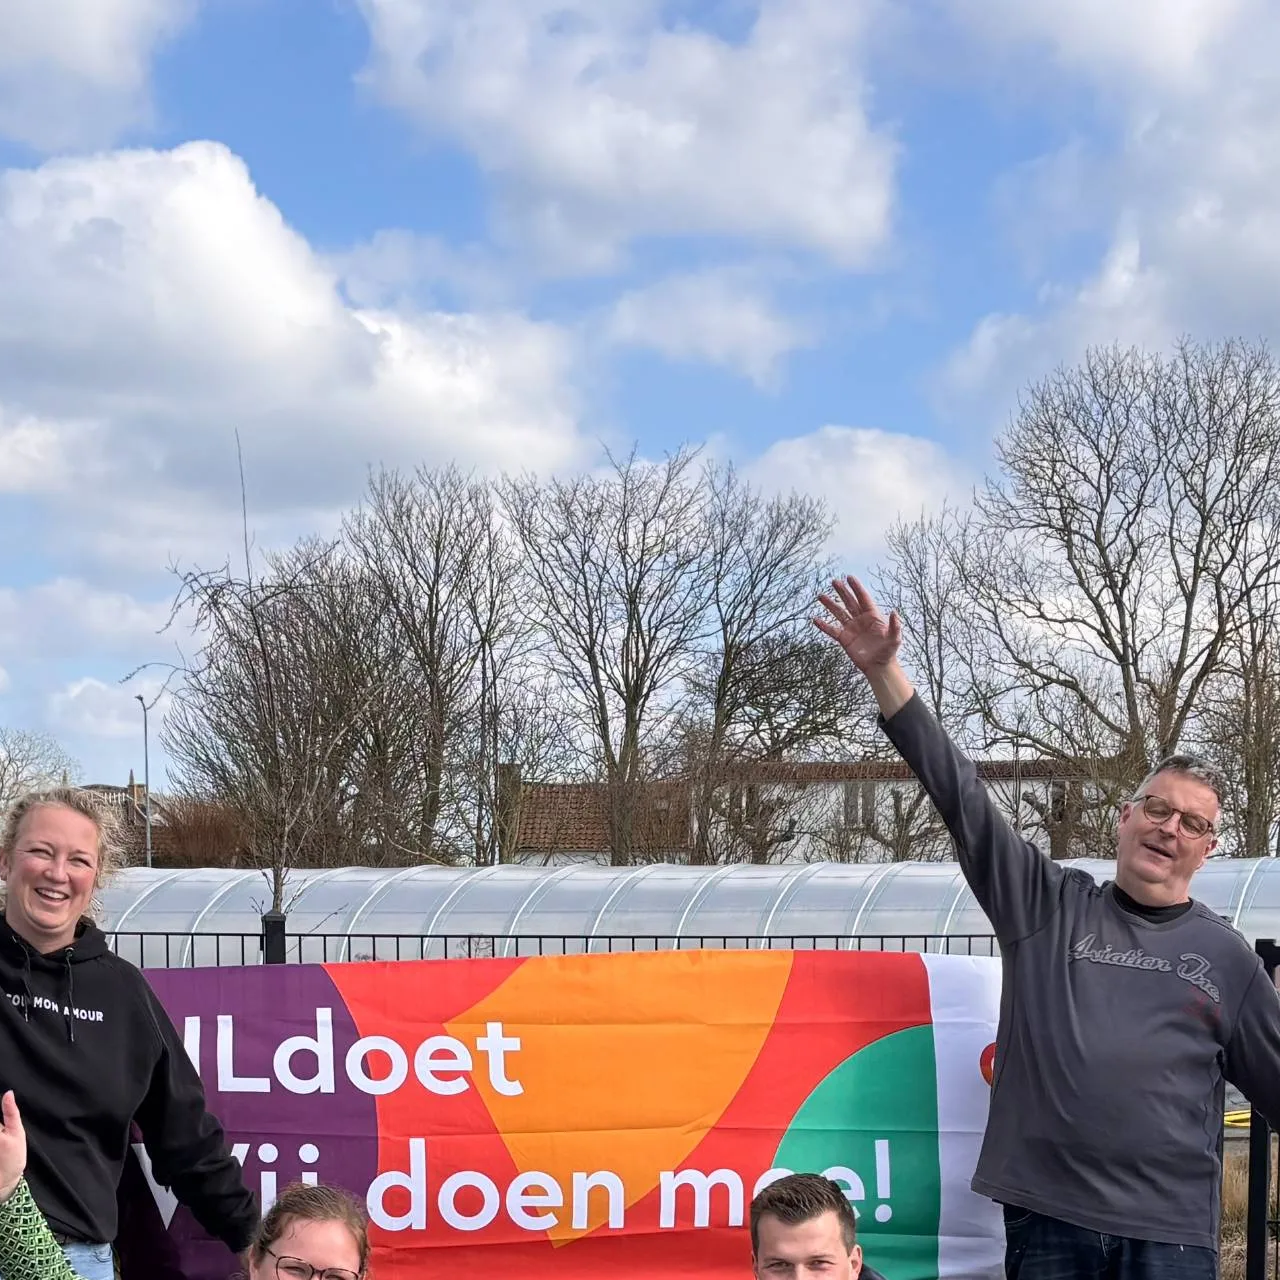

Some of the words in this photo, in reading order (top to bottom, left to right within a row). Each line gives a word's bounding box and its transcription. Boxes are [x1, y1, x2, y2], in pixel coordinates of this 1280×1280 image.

[33, 996, 59, 1013] MON
[63, 1006, 104, 1022] AMOUR
[366, 1138, 624, 1232] doen
[660, 1139, 893, 1229] me!
